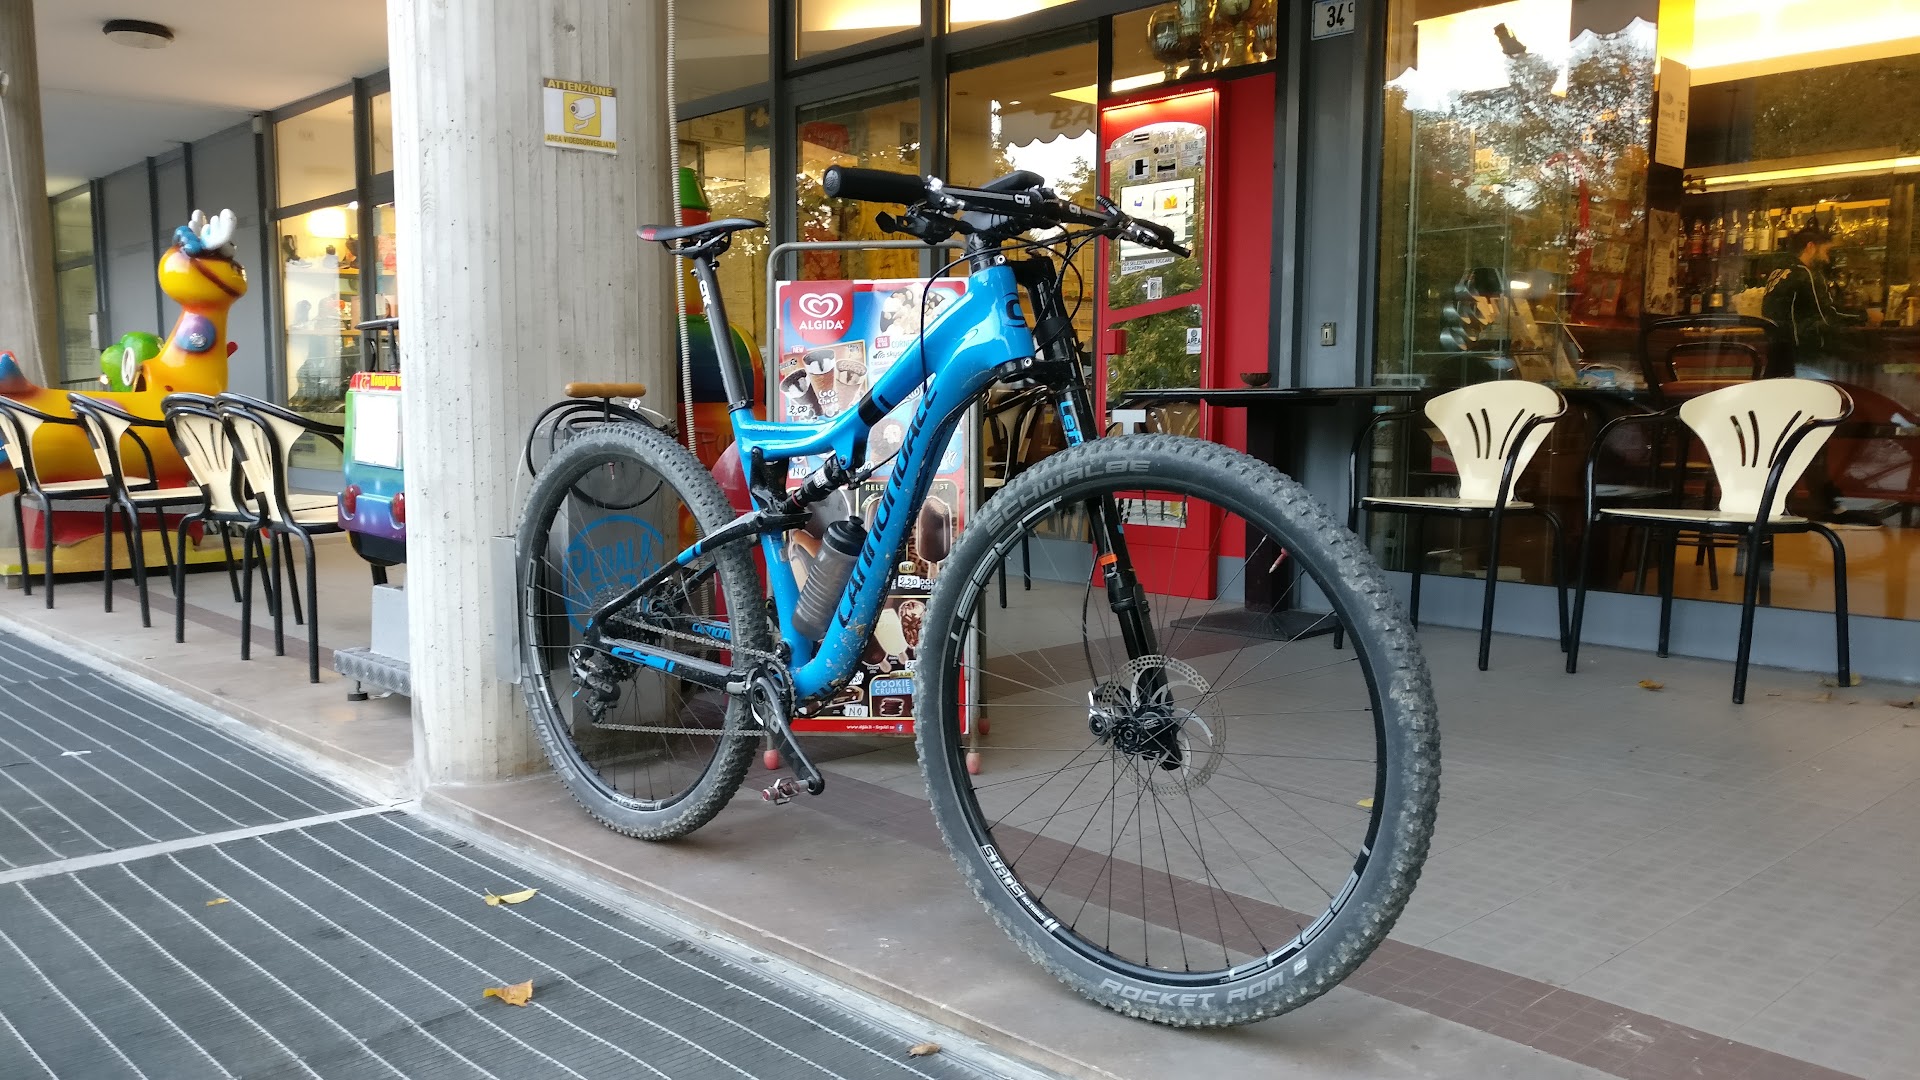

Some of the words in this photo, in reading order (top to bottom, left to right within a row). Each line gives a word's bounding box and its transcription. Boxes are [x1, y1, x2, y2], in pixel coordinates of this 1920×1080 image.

[1327, 4, 1345, 28] 34
[547, 79, 613, 97] ATTENZIONE
[547, 134, 563, 143] AREA
[563, 136, 616, 150] VIDEOSORVEGLIATA
[799, 319, 844, 330] ALGIDA
[792, 346, 805, 354] NEW
[985, 460, 1152, 537] SCHWALBE
[901, 564, 915, 572] NEW
[874, 679, 911, 688] COOKIE
[874, 687, 911, 695] CRUMBLE
[848, 707, 863, 716] NO
[982, 844, 1027, 898] STANS
[1100, 977, 1216, 1010] ROCKET
